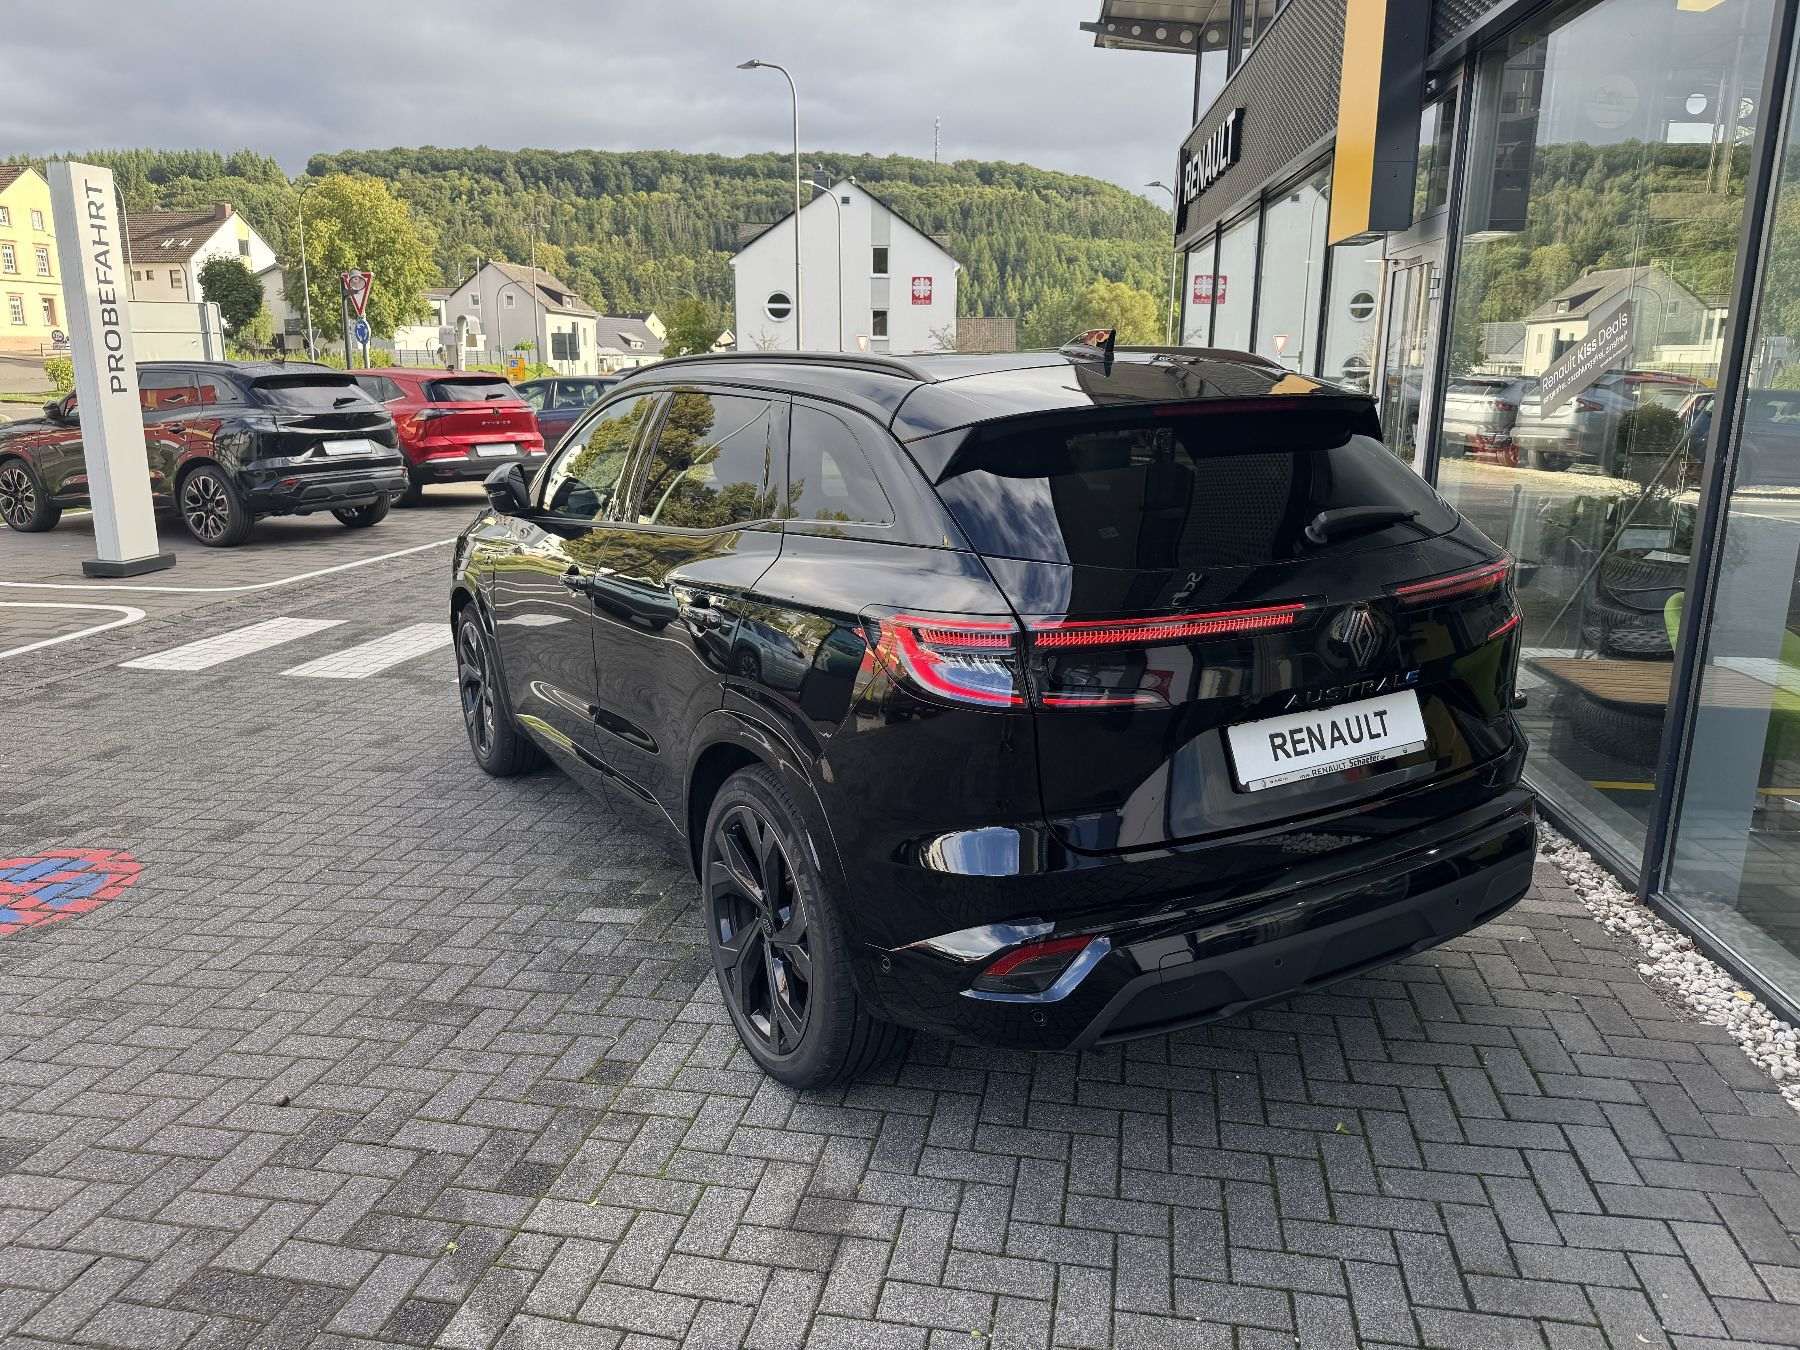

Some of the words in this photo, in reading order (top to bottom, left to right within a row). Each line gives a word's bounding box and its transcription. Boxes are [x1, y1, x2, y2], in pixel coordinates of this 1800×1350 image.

[1183, 108, 1236, 204] RENAULT
[84, 179, 127, 394] PROBEFAHRT
[1542, 354, 1577, 392] Renault
[1577, 338, 1597, 363] Kiss
[1599, 312, 1628, 346] Deals
[1269, 710, 1388, 762] RENAULT
[1311, 762, 1347, 777] RENAULT
